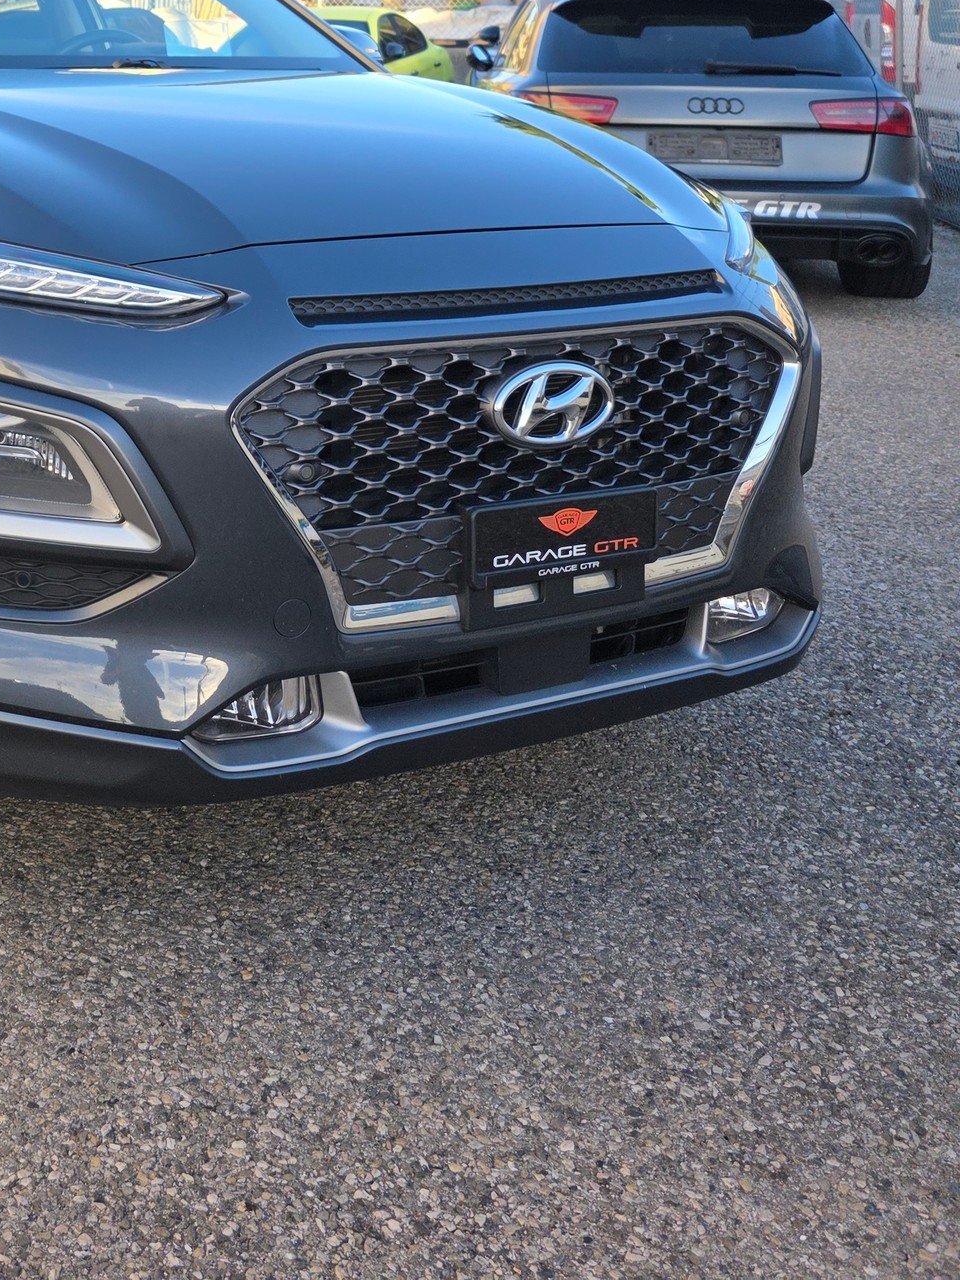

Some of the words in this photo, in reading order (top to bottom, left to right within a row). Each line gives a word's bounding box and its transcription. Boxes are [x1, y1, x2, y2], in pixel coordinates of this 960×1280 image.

[753, 200, 822, 219] GTR
[560, 517, 575, 525] GTR
[493, 544, 587, 568] GARAGE
[594, 537, 639, 553] GTR
[538, 564, 578, 577] GARAGE
[580, 561, 600, 571] GTR
